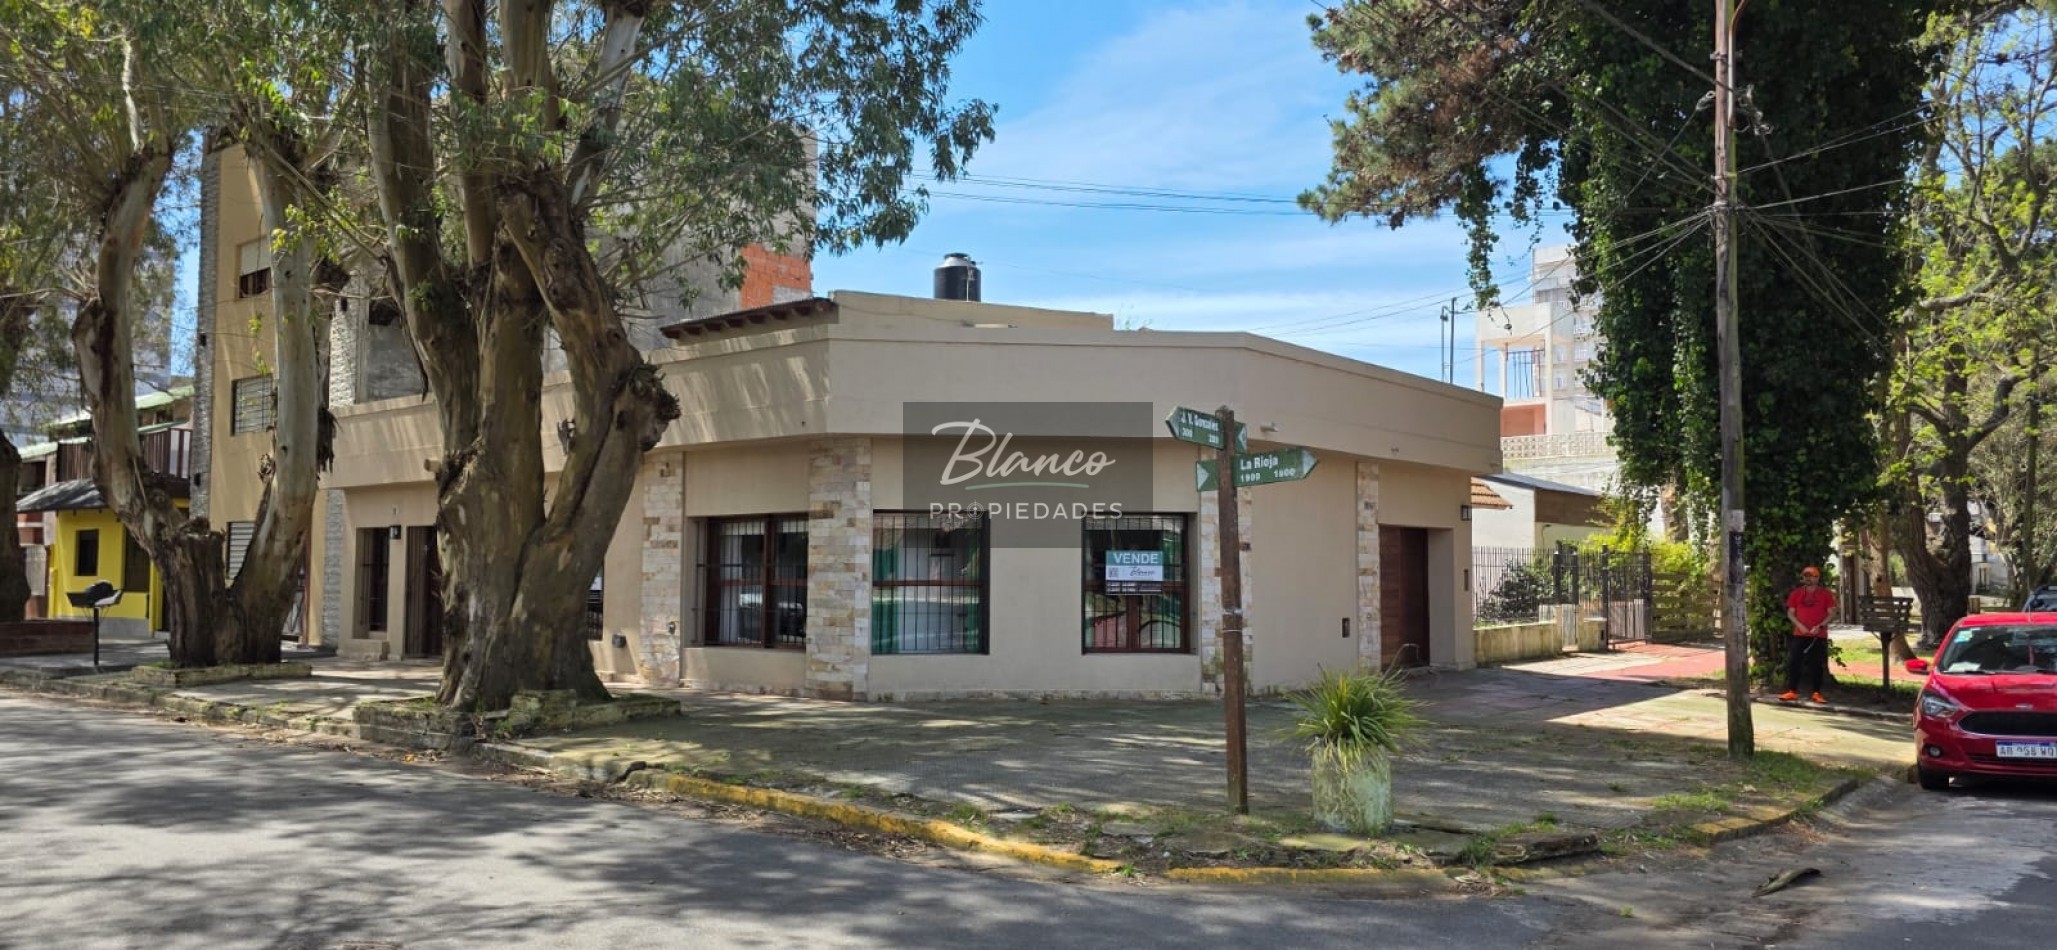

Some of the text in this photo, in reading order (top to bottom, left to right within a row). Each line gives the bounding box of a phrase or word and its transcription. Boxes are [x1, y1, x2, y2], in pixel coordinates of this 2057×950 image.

[1240, 454, 1279, 470] La Rioja
[1113, 553, 1159, 564] VENDE
